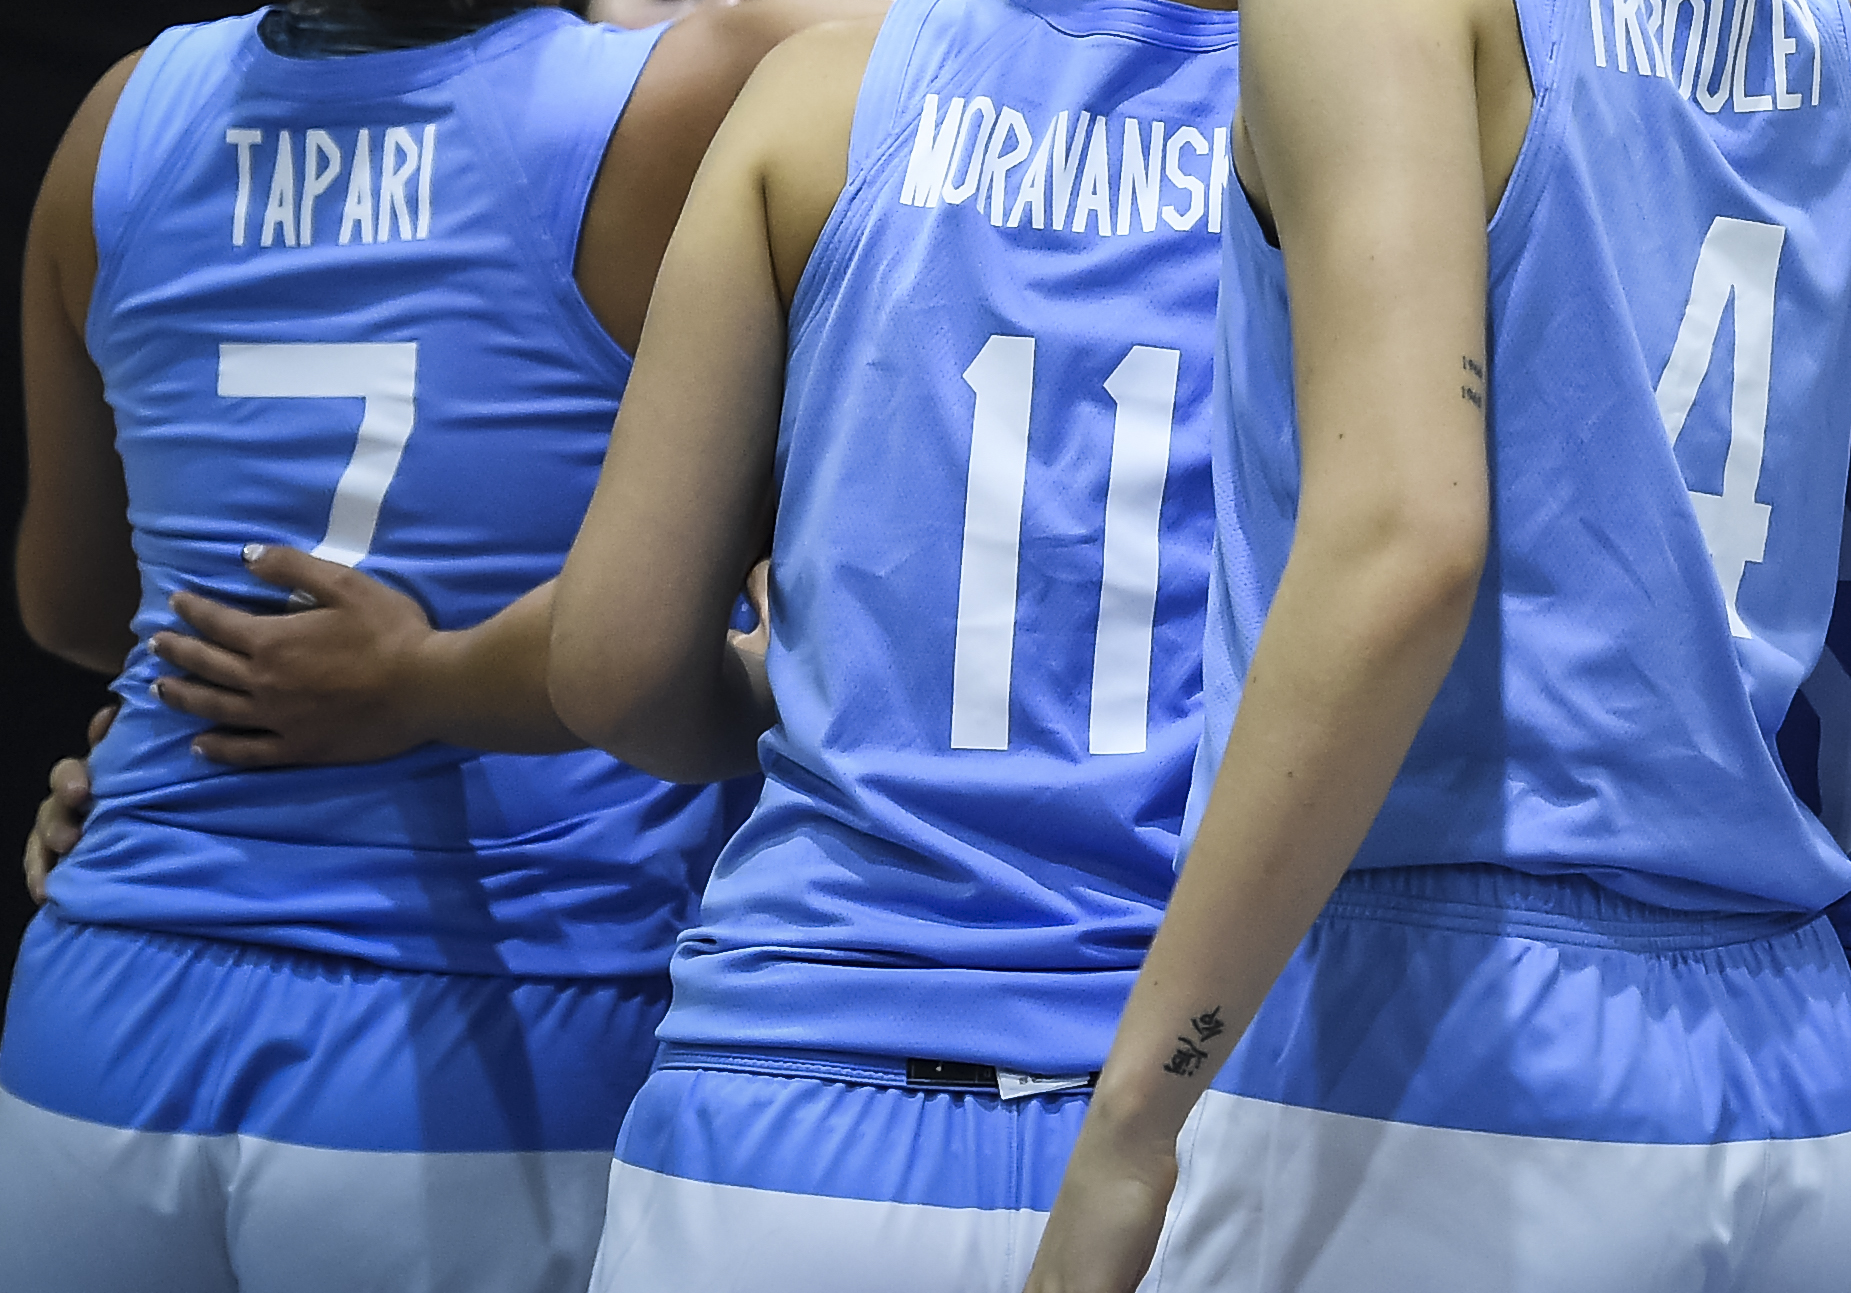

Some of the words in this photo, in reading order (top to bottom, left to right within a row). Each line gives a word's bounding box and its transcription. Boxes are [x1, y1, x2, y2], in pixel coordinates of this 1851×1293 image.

[226, 123, 436, 248] TAPARI
[217, 342, 417, 605] 7
[950, 334, 1181, 756] 11
[1655, 215, 1787, 638] 4
